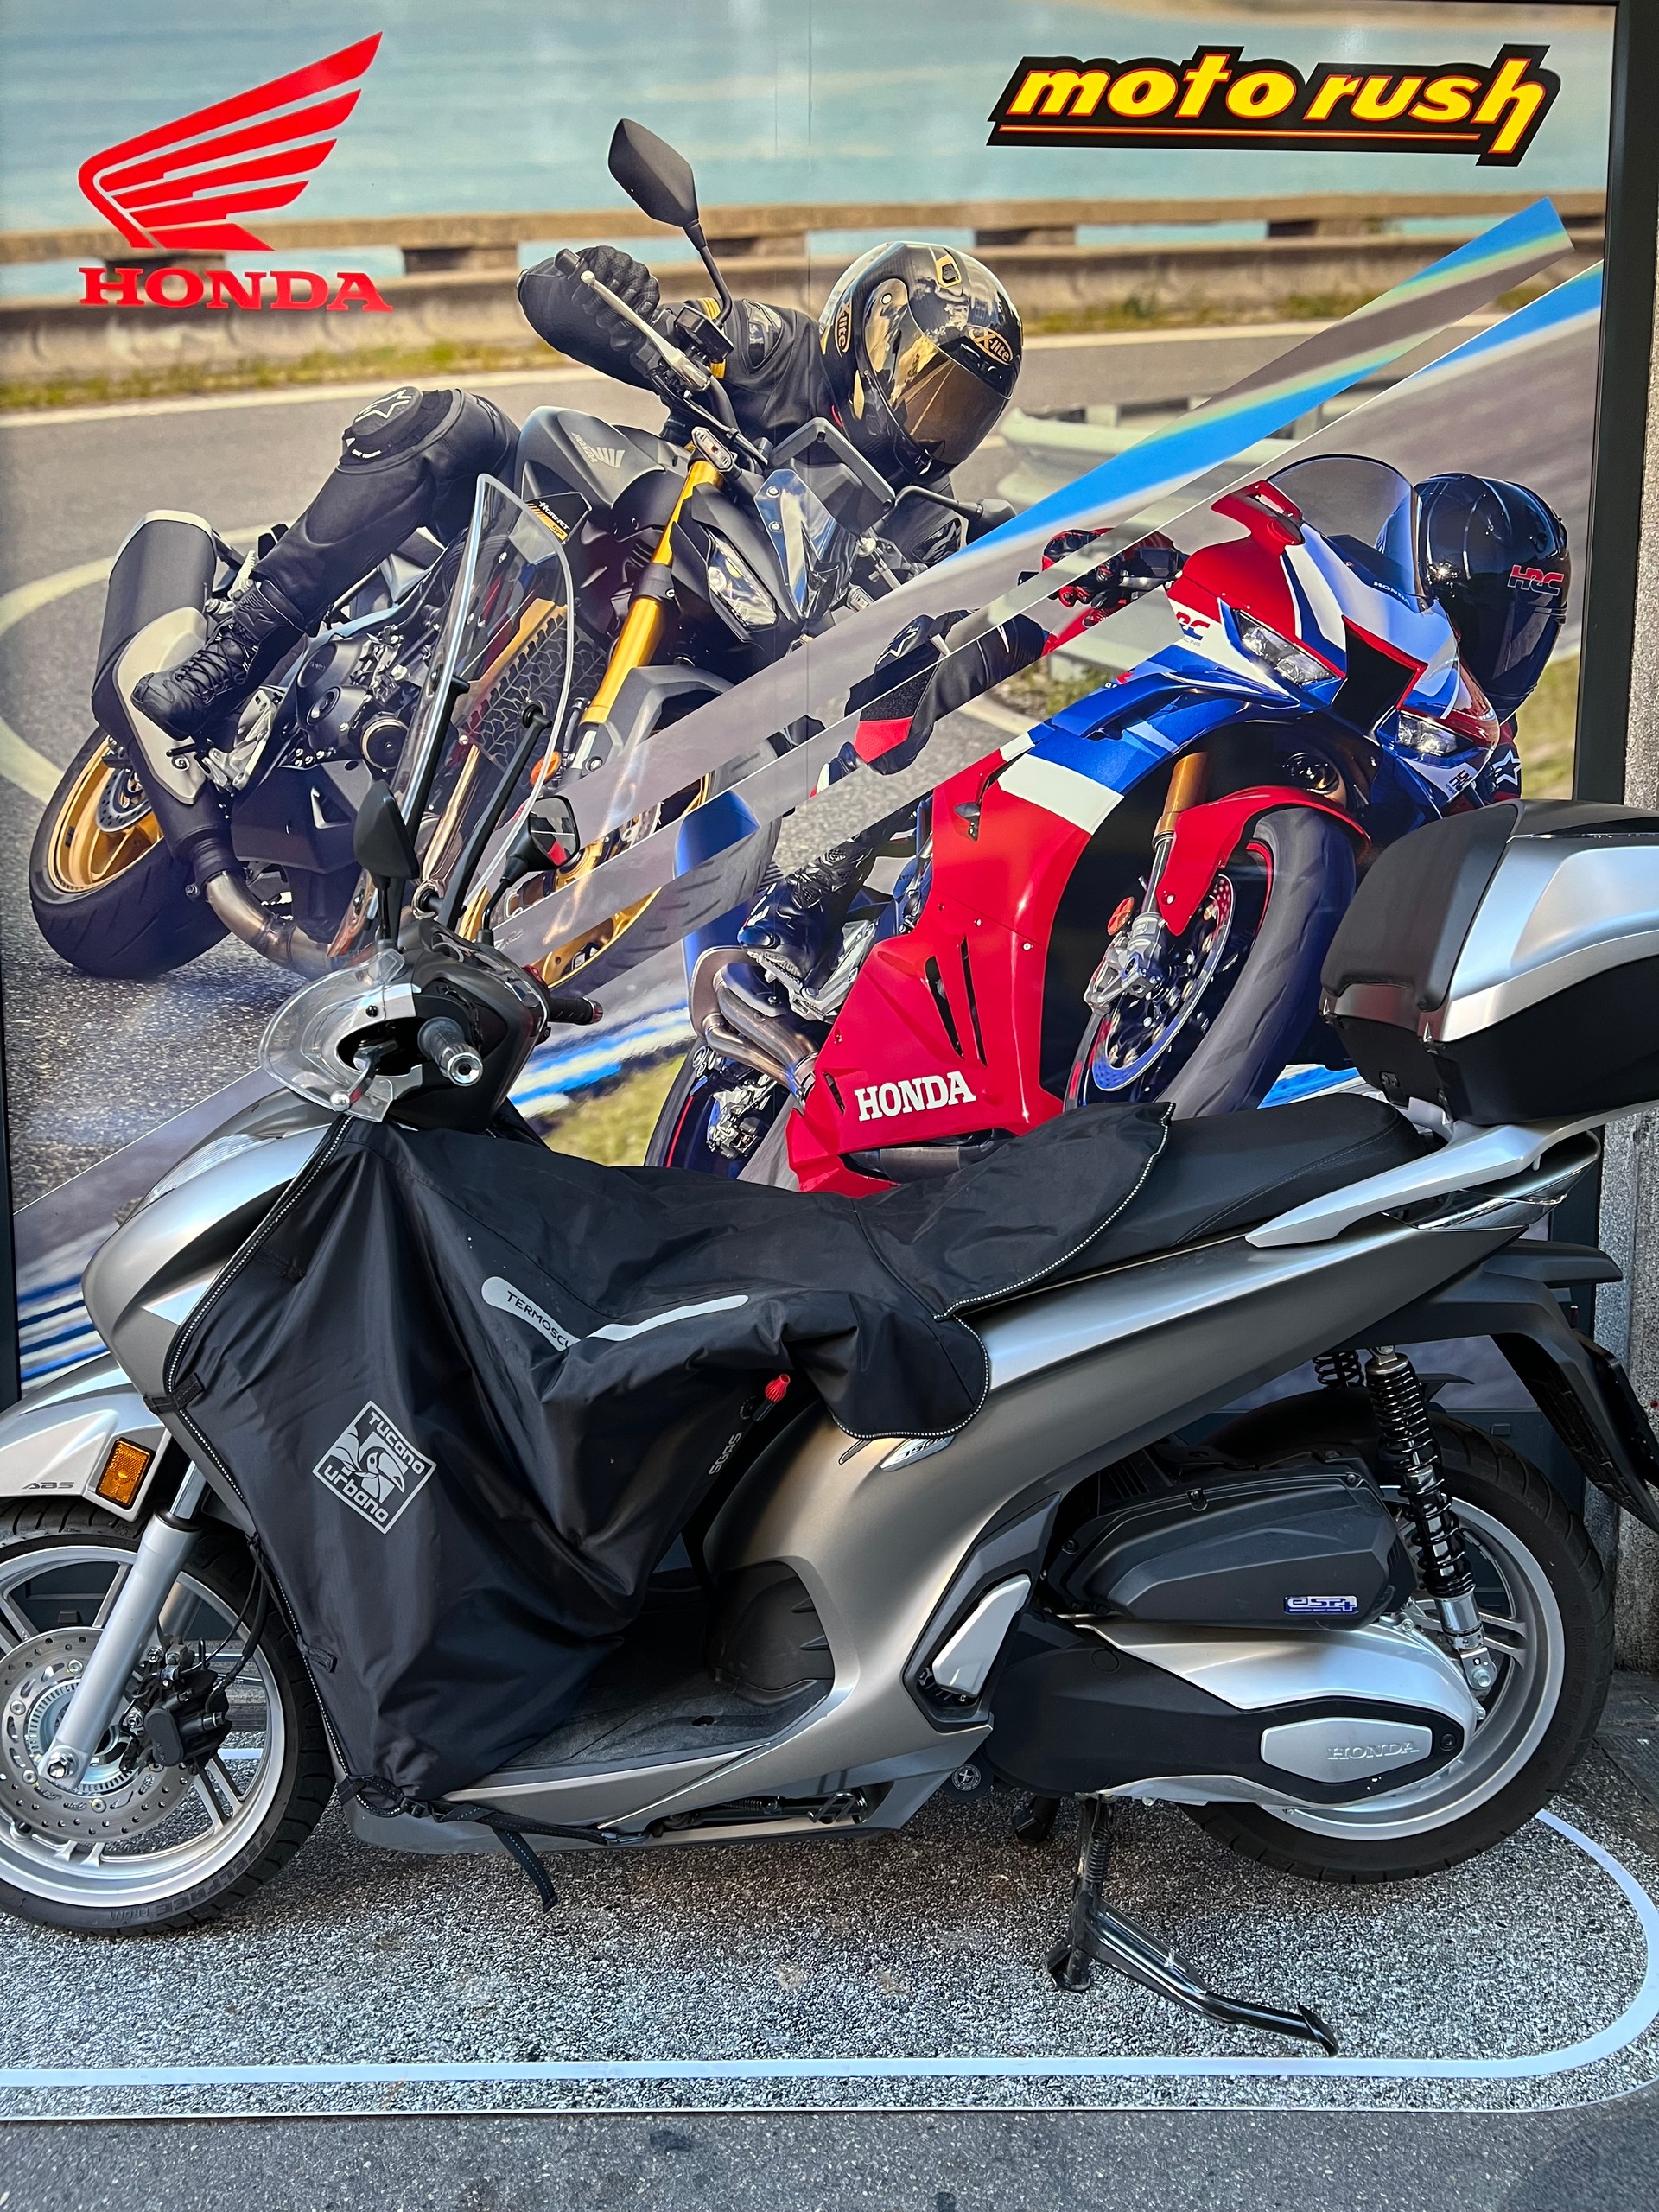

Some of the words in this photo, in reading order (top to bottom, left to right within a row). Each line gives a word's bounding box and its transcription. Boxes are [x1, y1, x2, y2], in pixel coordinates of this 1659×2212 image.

[1006, 54, 1297, 119] moto
[1303, 57, 1547, 154] rush
[78, 267, 394, 312] HONDA
[973, 327, 1012, 361] X-lite
[1372, 580, 1412, 607] HONDA
[1507, 564, 1565, 596] HRC
[854, 1071, 977, 1122] HONDA
[22, 1481, 75, 1490] ABS
[1327, 1741, 1420, 1760] HONDA
